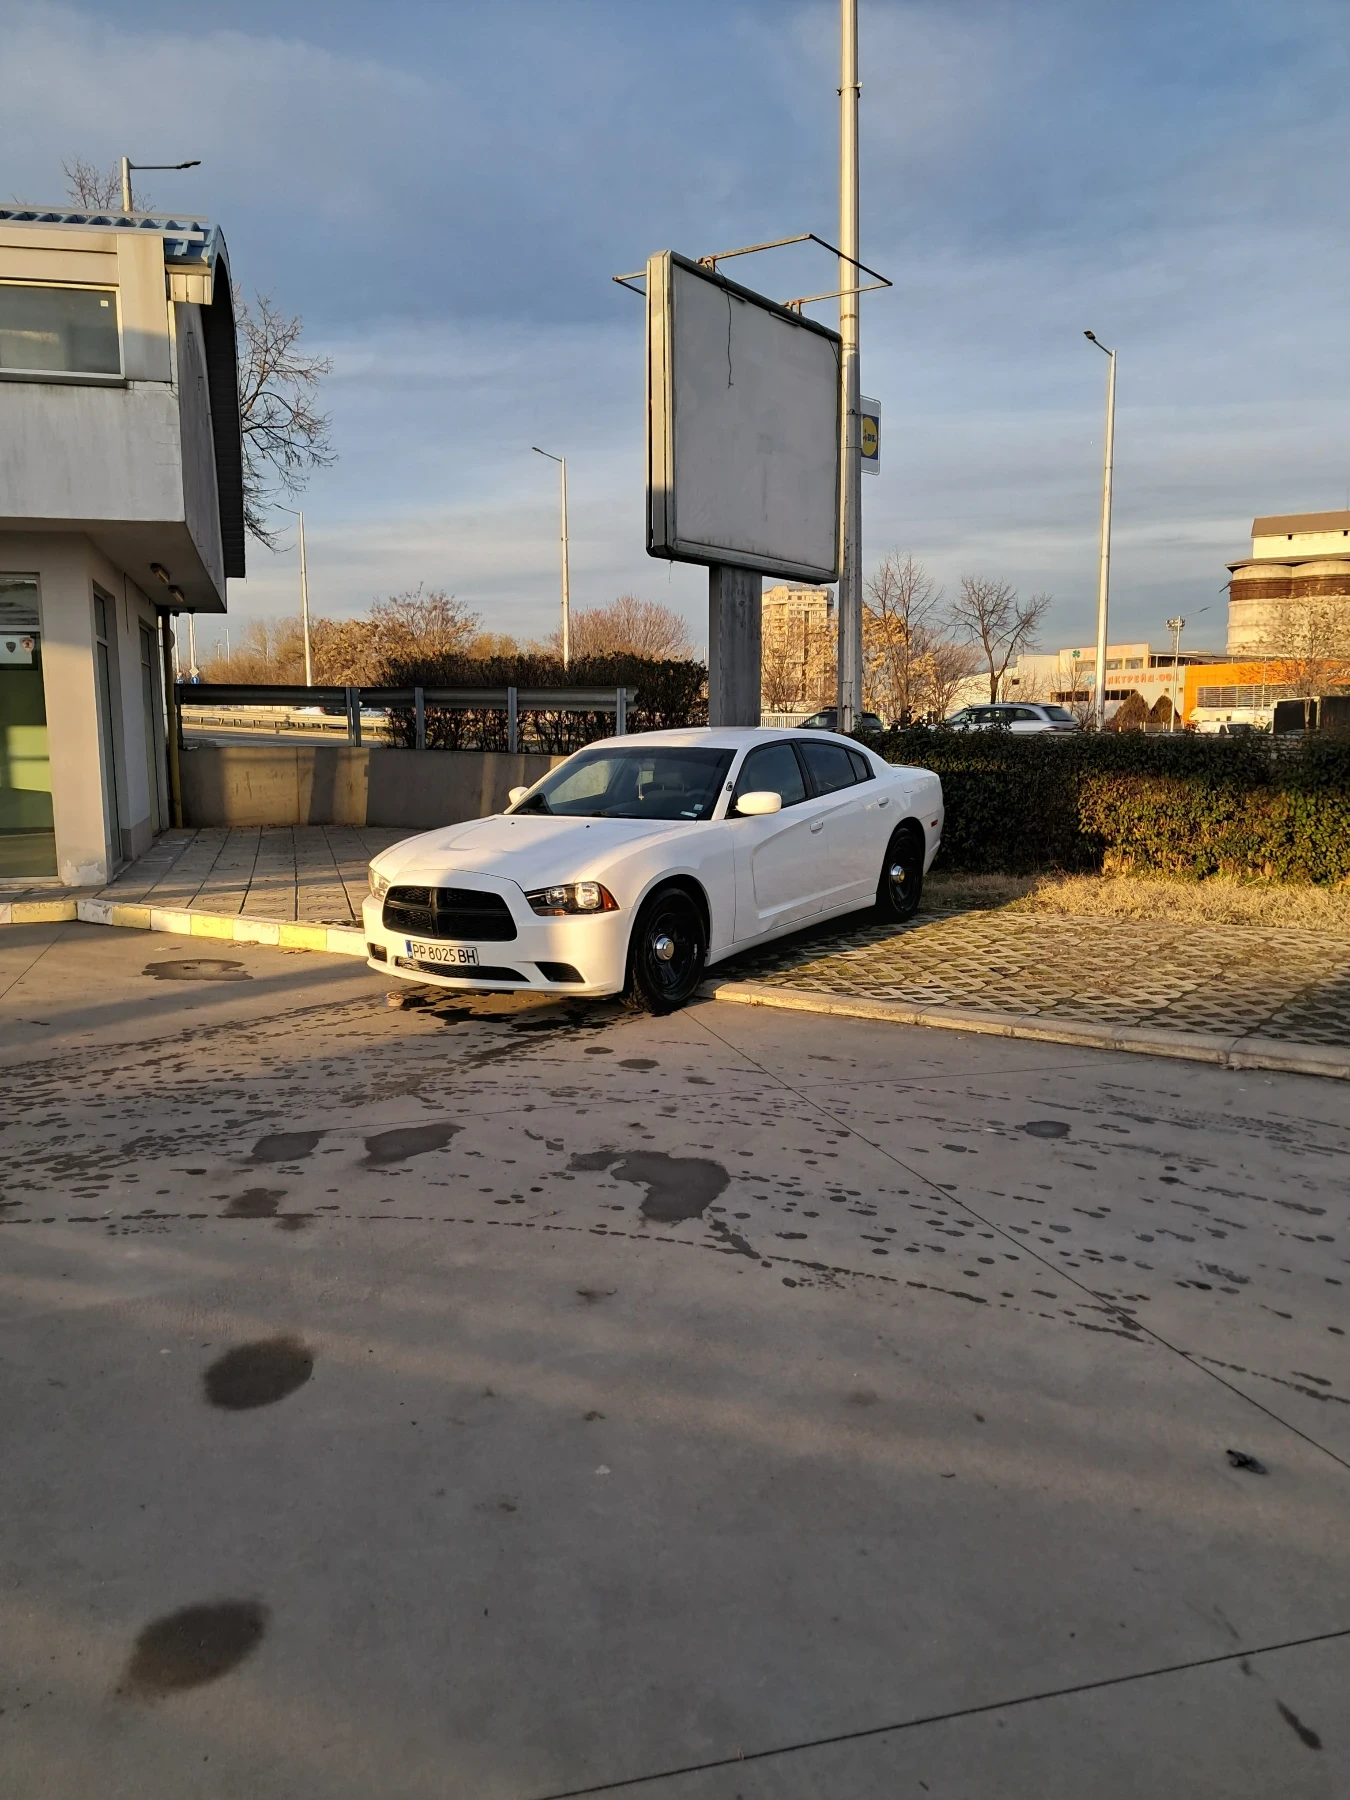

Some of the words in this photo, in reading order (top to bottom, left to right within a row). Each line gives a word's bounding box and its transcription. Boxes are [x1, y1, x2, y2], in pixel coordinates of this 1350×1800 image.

[412, 943, 426, 958] PP
[428, 946, 456, 962] 8025
[458, 949, 476, 964] BH
